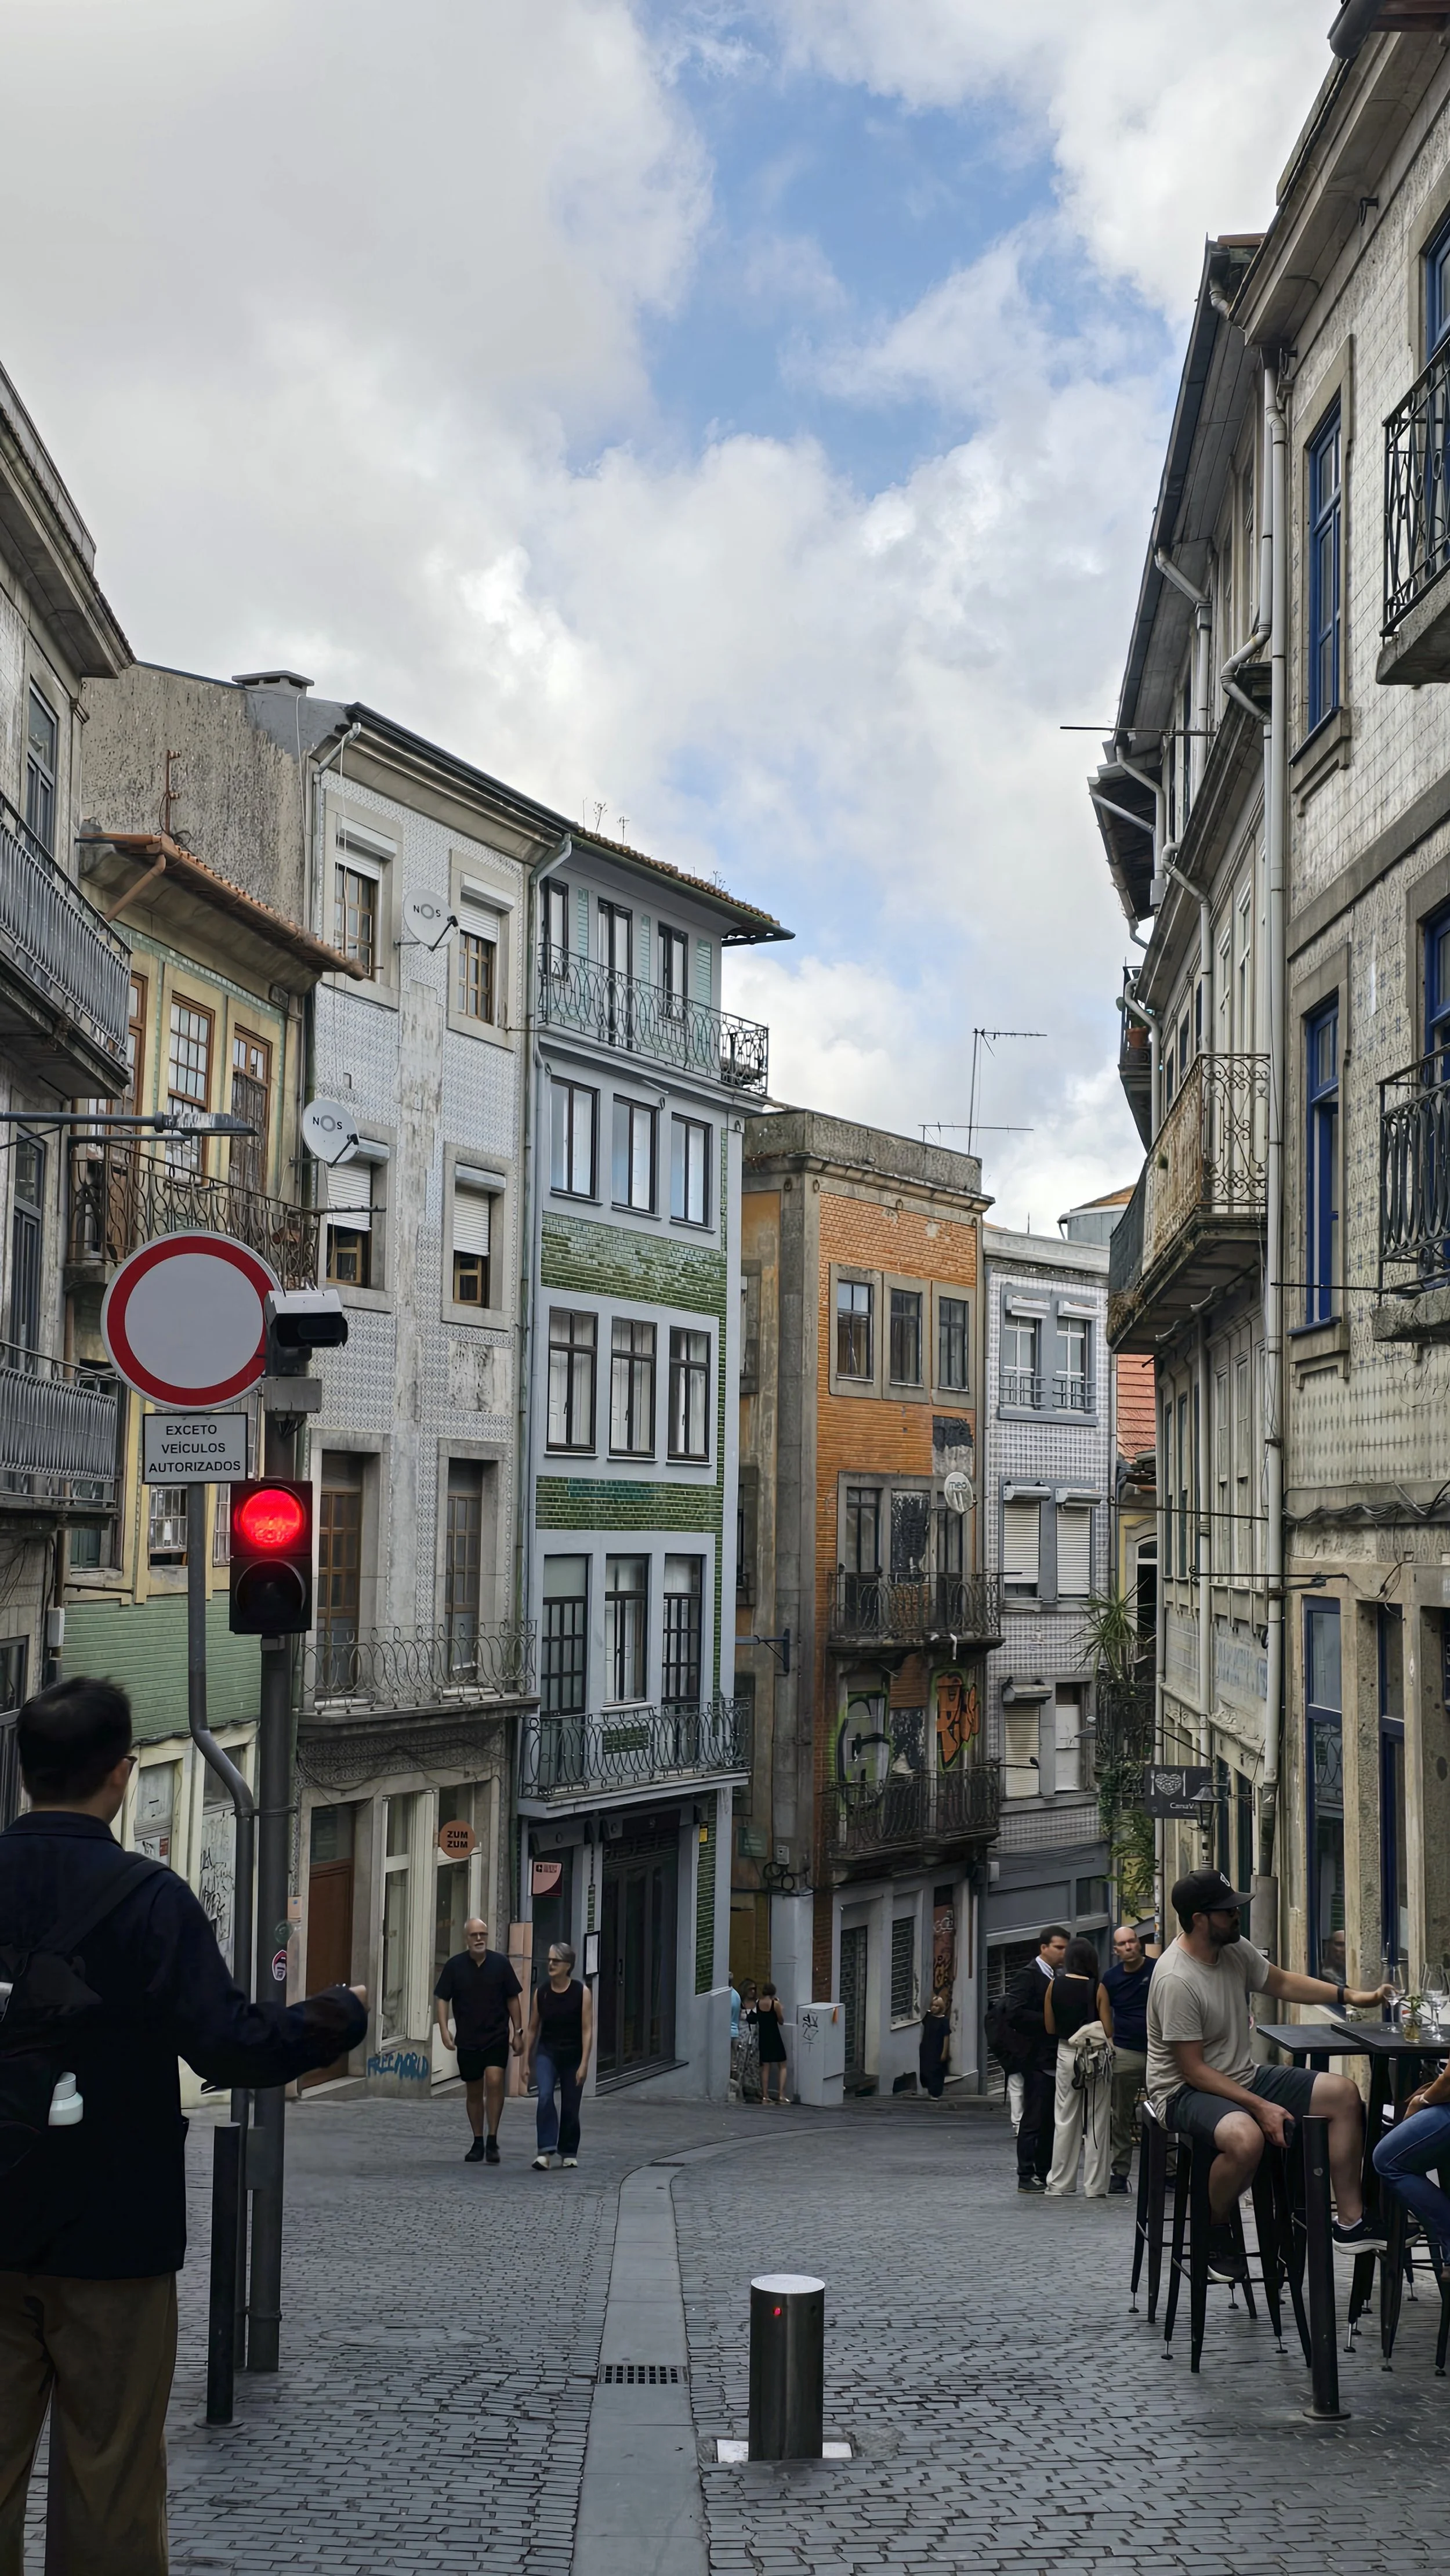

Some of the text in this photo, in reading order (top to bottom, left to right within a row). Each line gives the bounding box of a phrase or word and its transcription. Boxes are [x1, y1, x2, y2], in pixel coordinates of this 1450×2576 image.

[414, 903, 441, 920] NOS
[313, 1115, 342, 1132] NOS
[166, 1425, 217, 1435] EXCETO
[161, 1441, 226, 1454] VEÍCULOS
[148, 1461, 241, 1472] AUTORIZADOS
[447, 1830, 468, 1839] ZUM
